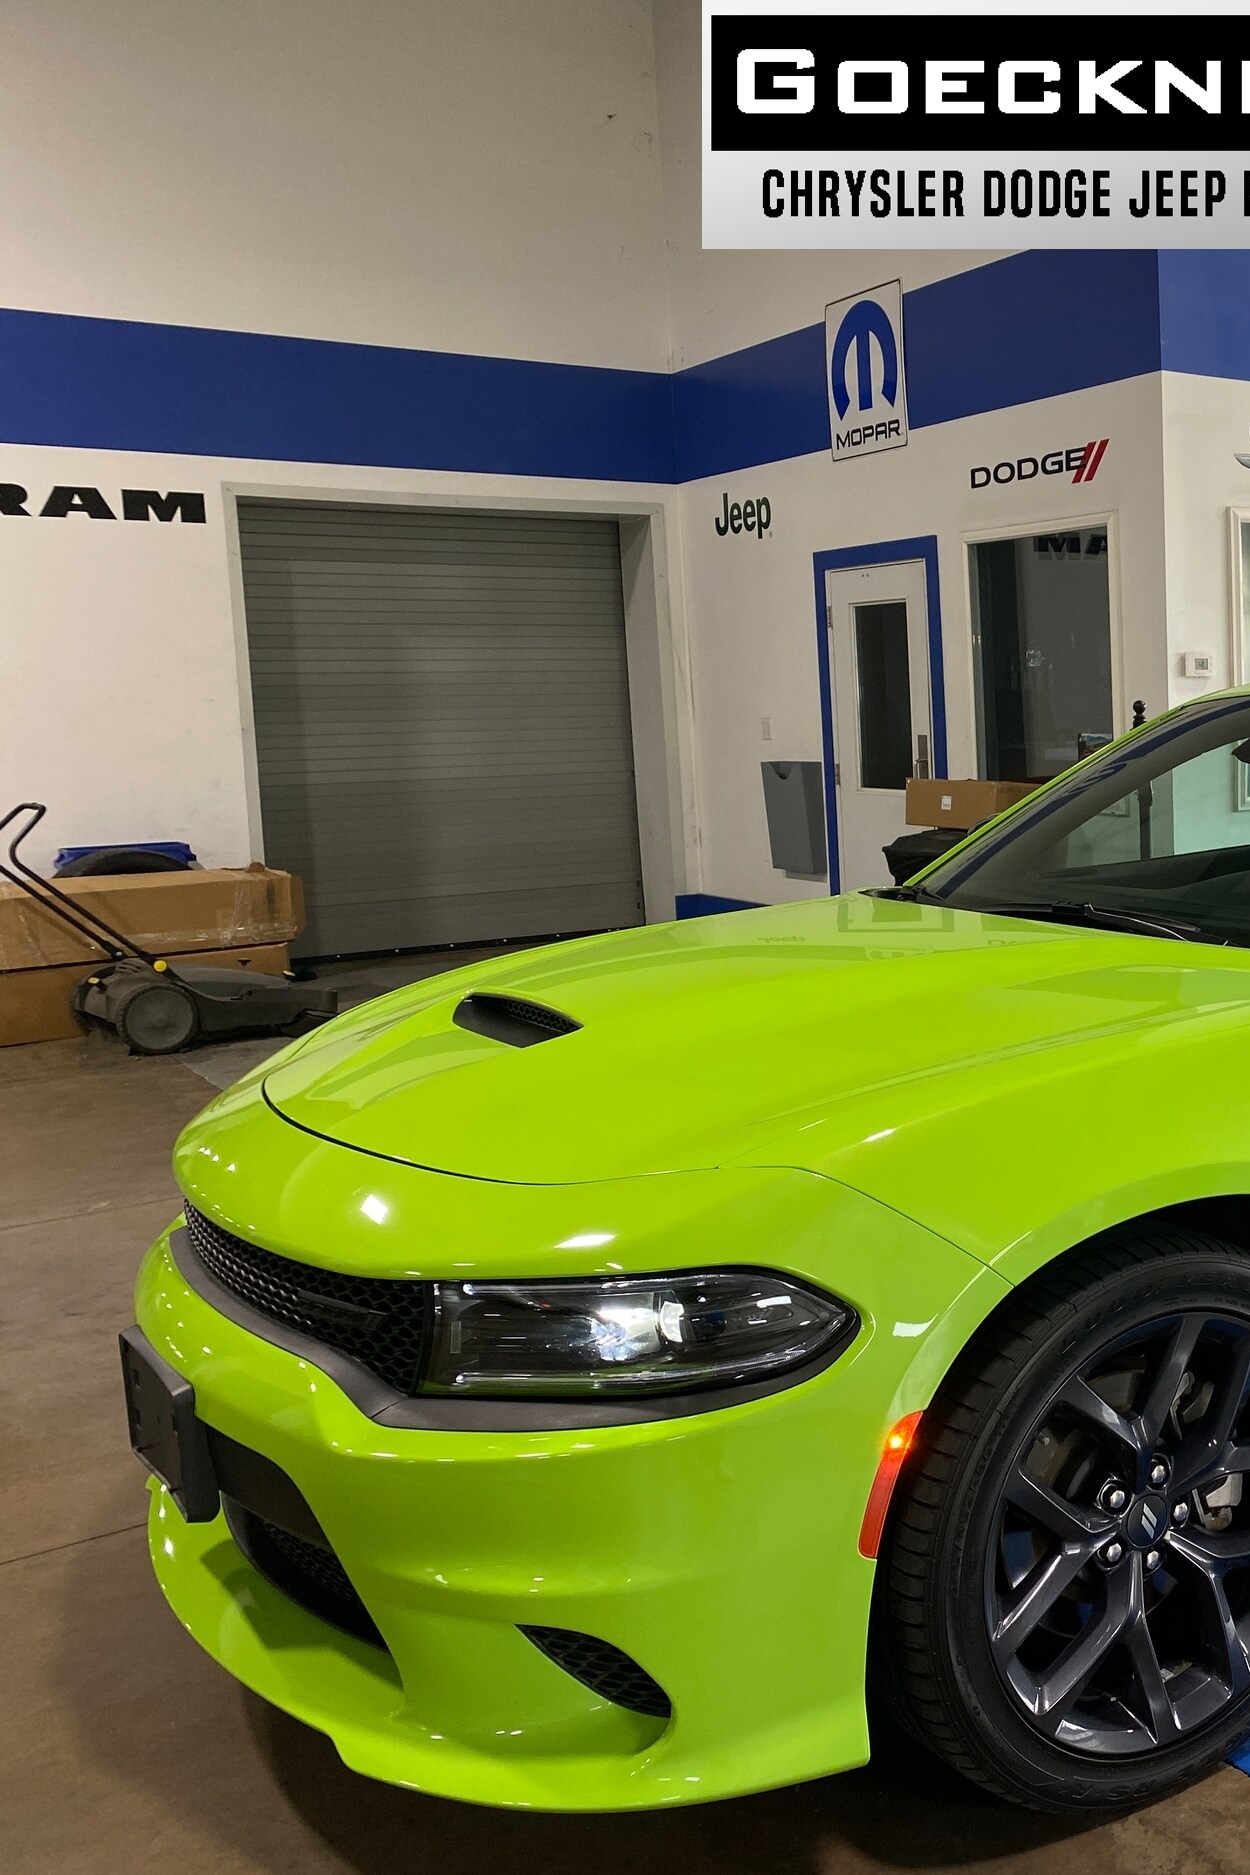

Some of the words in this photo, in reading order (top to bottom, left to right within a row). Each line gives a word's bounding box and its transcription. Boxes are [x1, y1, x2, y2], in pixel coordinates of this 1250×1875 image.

[836, 419, 902, 451] MOPAR
[970, 446, 1087, 488] DODGE
[715, 492, 772, 539] Jeep
